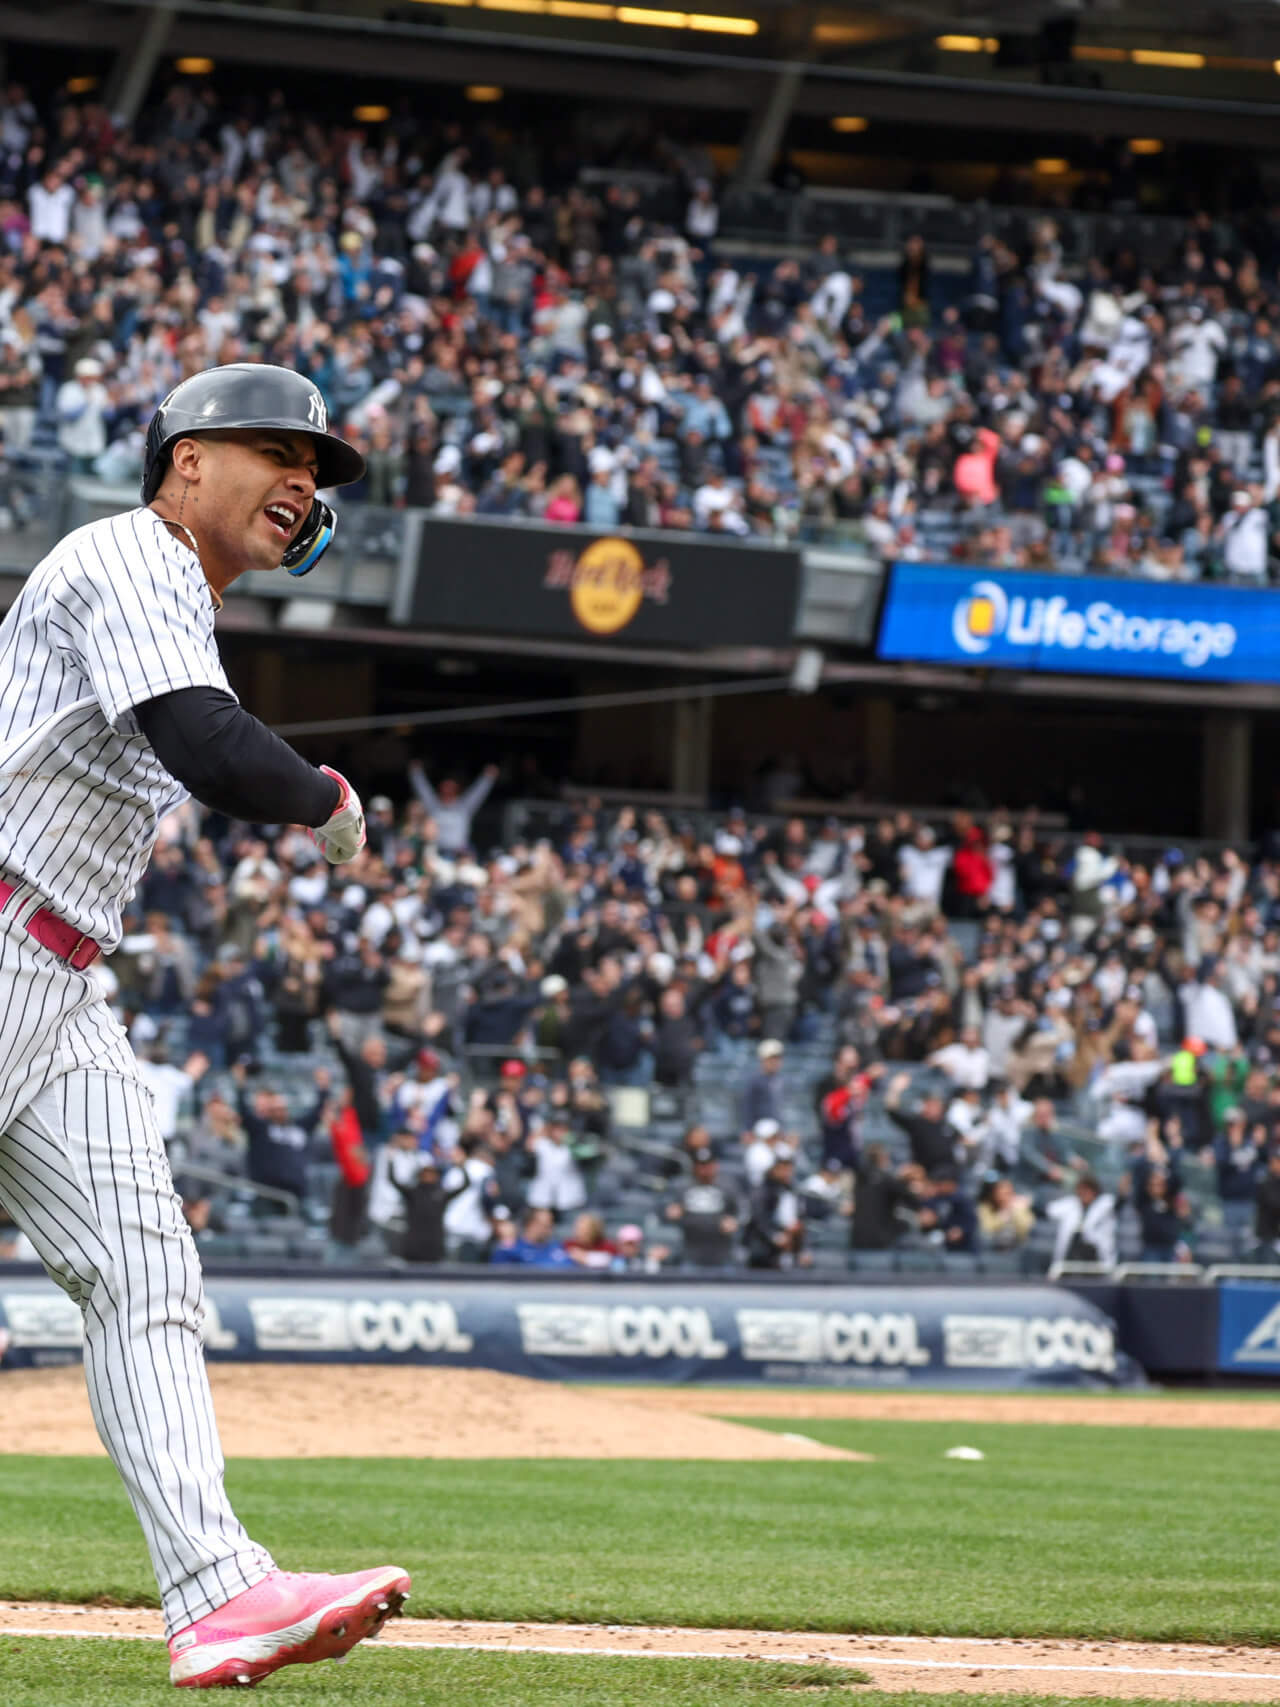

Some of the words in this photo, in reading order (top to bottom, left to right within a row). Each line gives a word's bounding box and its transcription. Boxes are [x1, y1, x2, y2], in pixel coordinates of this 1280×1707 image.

[308, 392, 327, 433] NY
[348, 1299, 473, 1352] COOL
[609, 1306, 728, 1359] COOL
[824, 1312, 930, 1366] COOL
[1026, 1317, 1116, 1373] COOL
